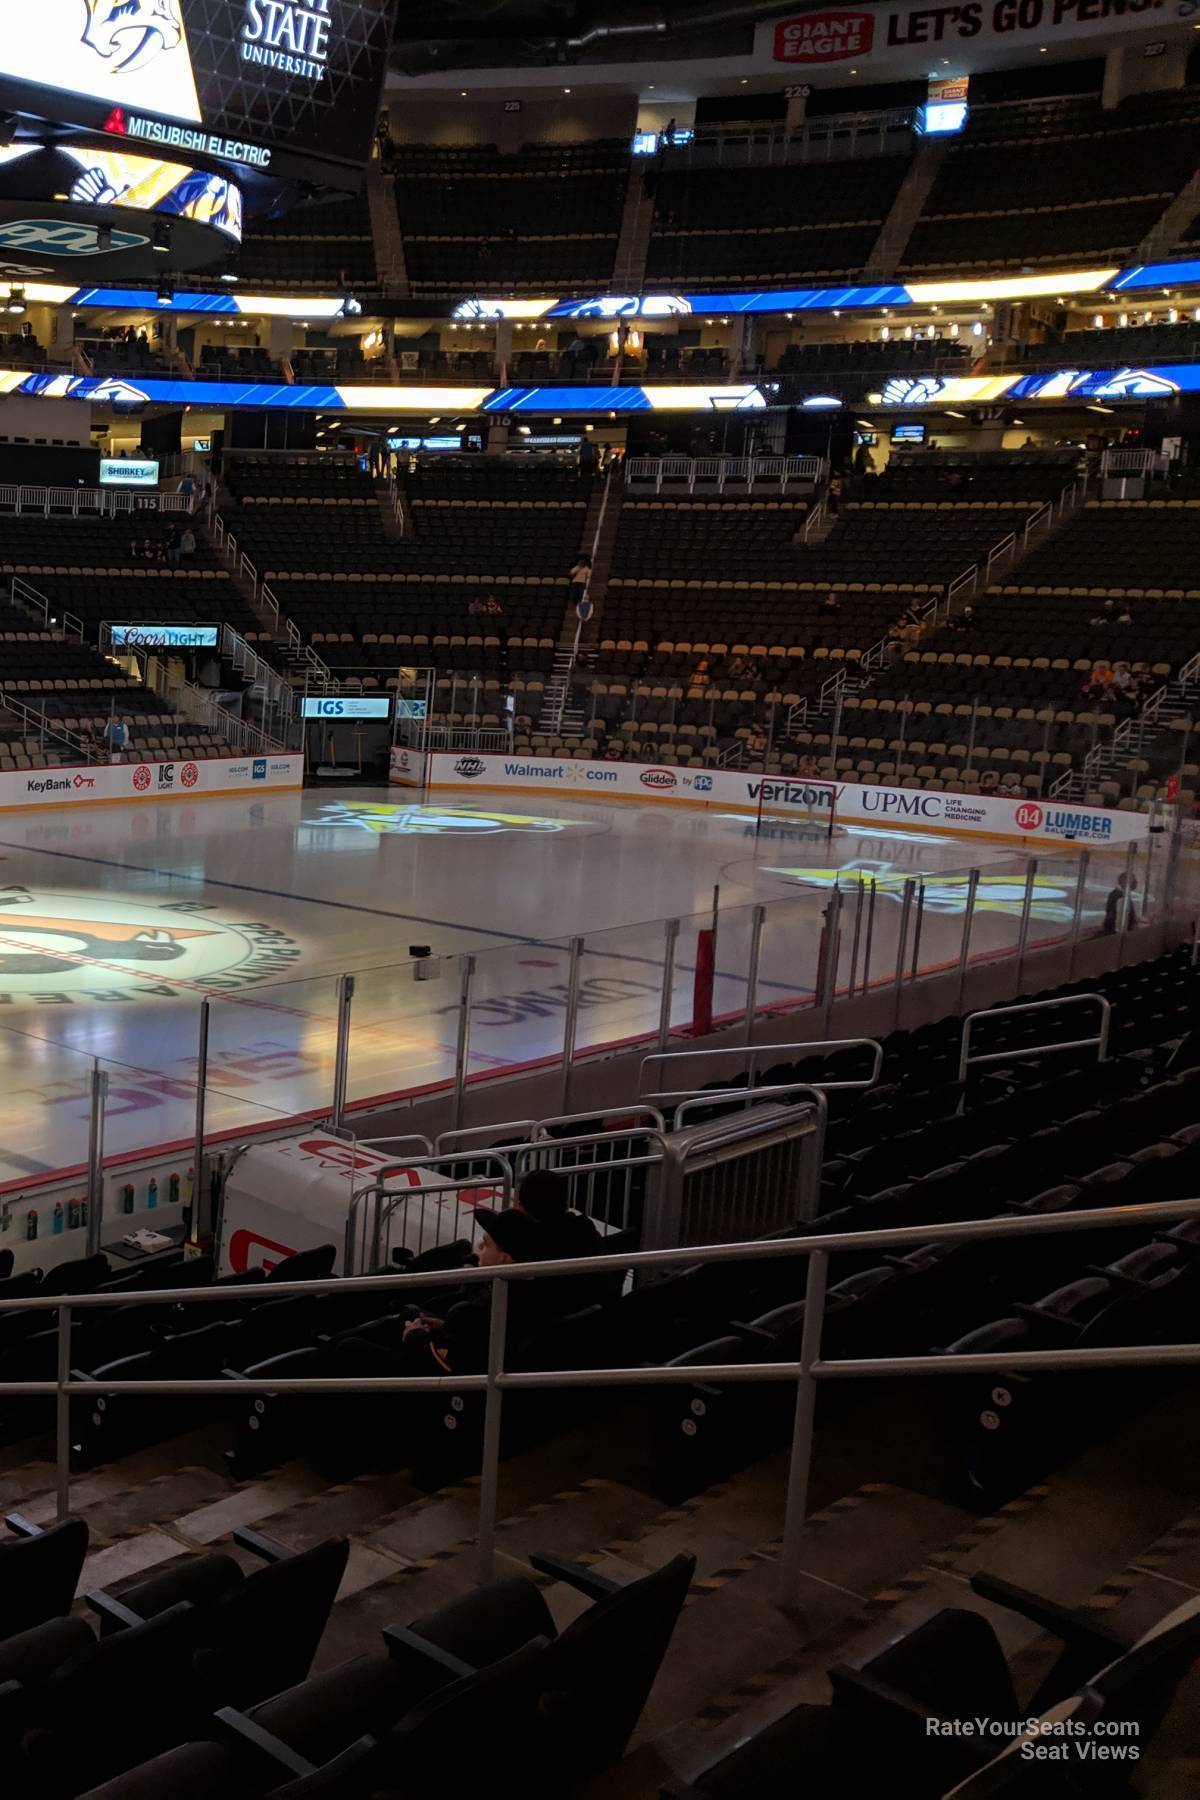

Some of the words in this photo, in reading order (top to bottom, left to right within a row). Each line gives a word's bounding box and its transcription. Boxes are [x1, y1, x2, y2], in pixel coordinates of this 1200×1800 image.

[243, 0, 331, 60] STATE
[784, 19, 865, 41] GIANT
[887, 1, 983, 47] LET'S
[992, 0, 1040, 32] GO
[782, 35, 862, 57] EAGLE
[242, 42, 327, 81] UNIVERSITY
[784, 85, 810, 98] 226
[129, 117, 206, 150] MITSUBISHI
[208, 136, 272, 167] ELECTRIC
[488, 415, 512, 427] 116
[137, 497, 158, 510] 115
[124, 628, 166, 645] Coors
[168, 634, 205, 645] LIGHT
[317, 701, 344, 715] IGS
[159, 764, 174, 782] IC
[454, 760, 487, 772] NHL
[504, 763, 564, 779] Walmart
[586, 769, 617, 781] com
[27, 778, 71, 793] KeyBank
[157, 782, 173, 790] LIGHT
[640, 772, 678, 786] Glidden
[683, 777, 693, 786] by
[748, 782, 834, 807] verizon
[862, 790, 941, 818] UPMC
[945, 806, 987, 816] CHANGING
[944, 813, 982, 823] MEDICINE
[1018, 807, 1041, 824] 84
[1045, 810, 1112, 834] LUMBER
